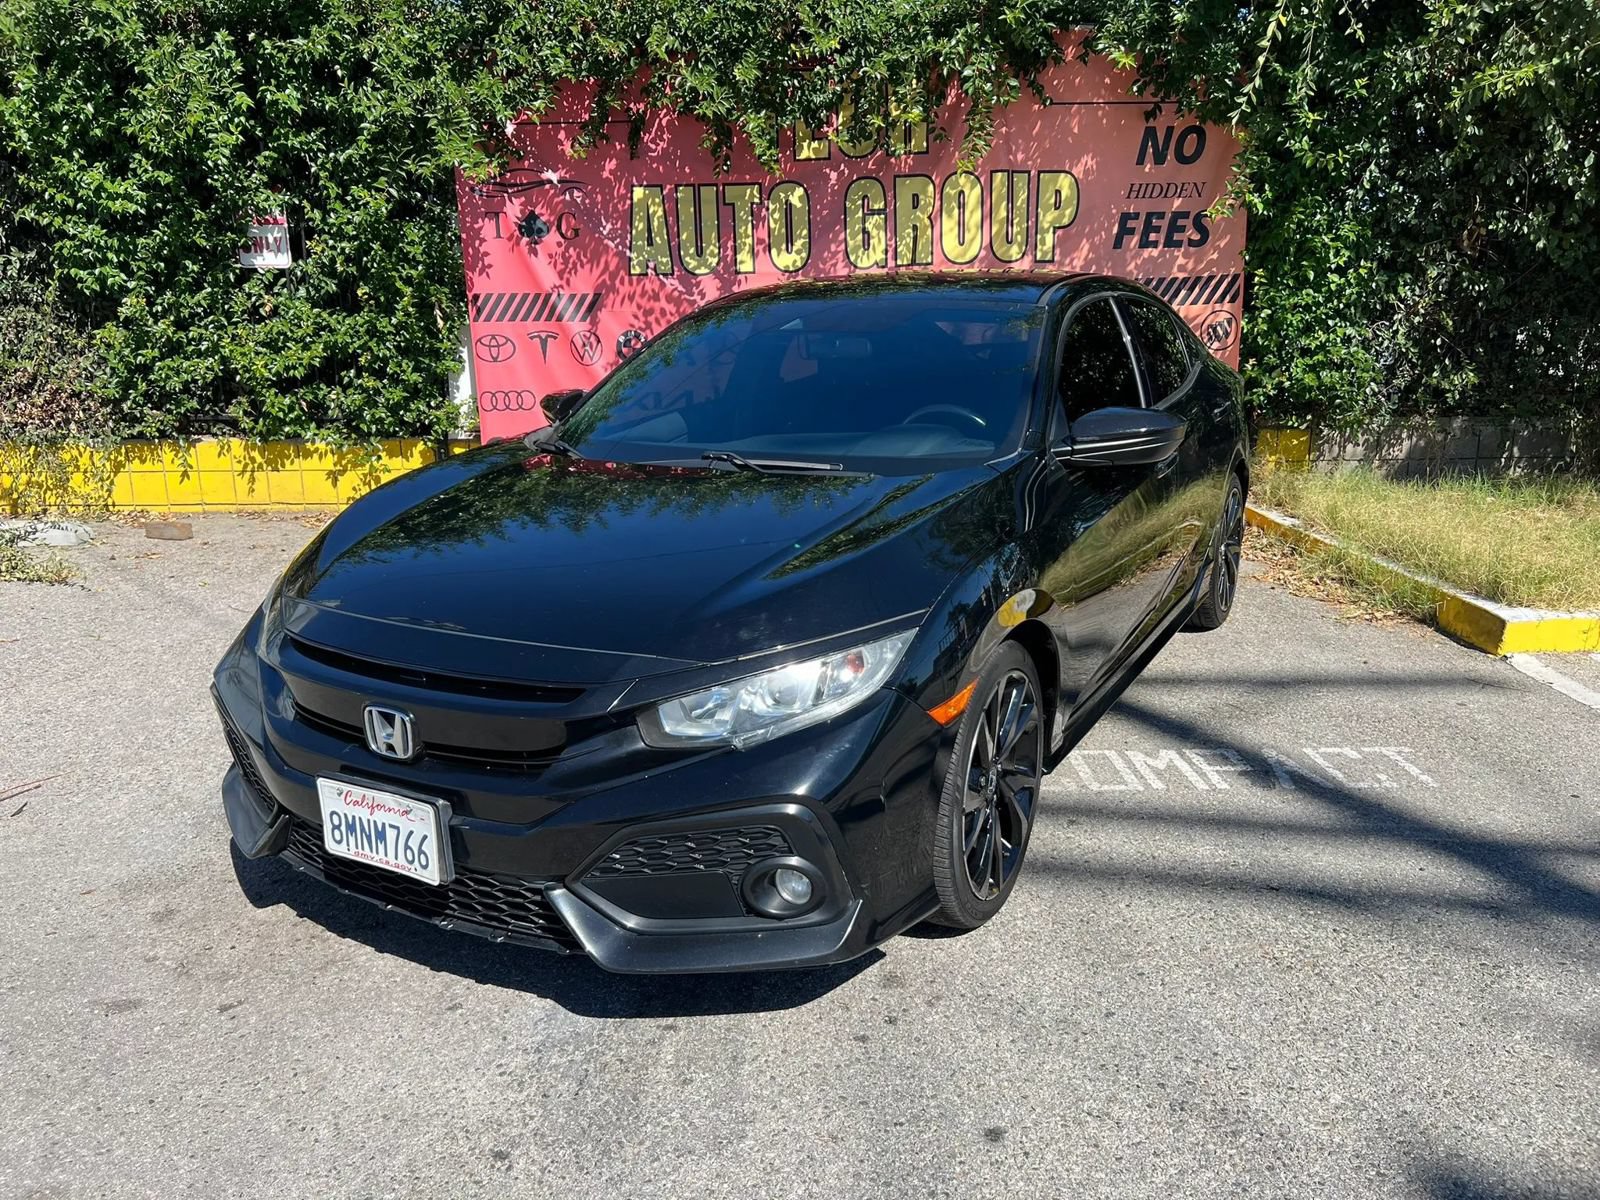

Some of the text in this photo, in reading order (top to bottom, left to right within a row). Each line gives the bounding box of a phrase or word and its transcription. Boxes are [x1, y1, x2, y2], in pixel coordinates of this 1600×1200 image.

[1135, 124, 1207, 166] NO
[1125, 181, 1208, 199] HIDDEN
[630, 169, 1080, 275] AUTO GROUP
[1112, 208, 1211, 249] FEES
[1040, 747, 1438, 791] OMPACT
[343, 789, 416, 823] California
[329, 810, 430, 870] 8MNM766
